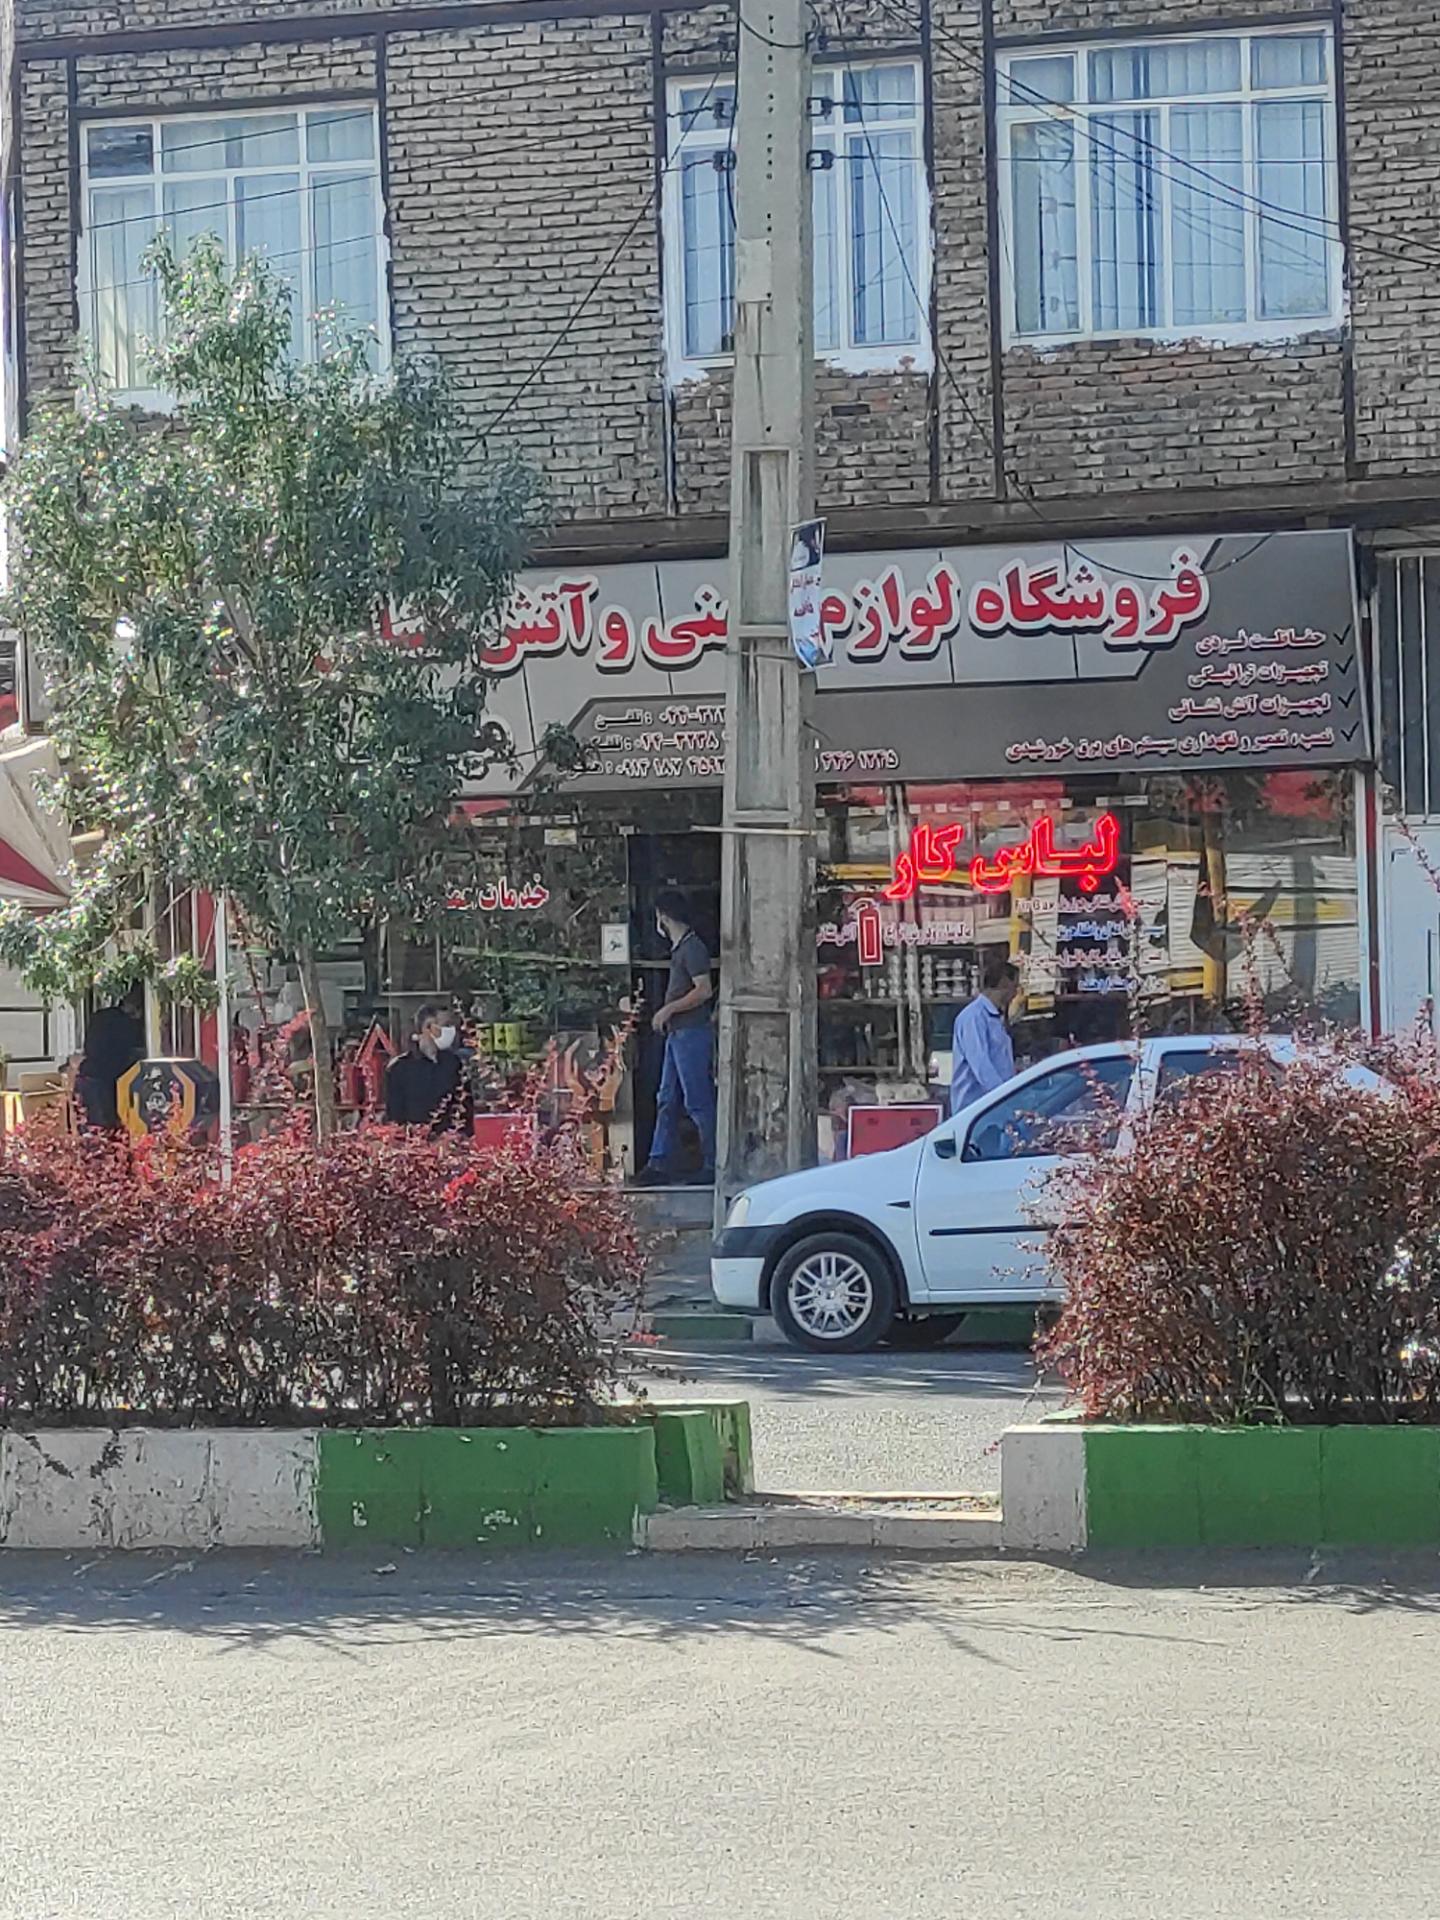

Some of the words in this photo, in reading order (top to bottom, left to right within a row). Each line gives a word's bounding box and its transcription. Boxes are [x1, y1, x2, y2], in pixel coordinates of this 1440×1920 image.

[819, 566, 957, 652] لوازم
[972, 549, 1206, 645] فروشگاه
[600, 609, 631, 662] و
[1196, 628, 1249, 656] فردی
[1250, 627, 1326, 649] حفاظت
[1188, 661, 1256, 689] ترافیکی
[1258, 660, 1329, 685] تجهیزات
[1168, 697, 1223, 722] نشانی
[1223, 693, 1259, 718] آتش
[1259, 692, 1332, 717] تجهیزات
[1005, 736, 1074, 762] خورشیدی
[1178, 730, 1238, 756] نگهداری
[883, 822, 964, 900] کار
[970, 812, 1120, 894] لباس
[478, 872, 550, 910] خدمات
